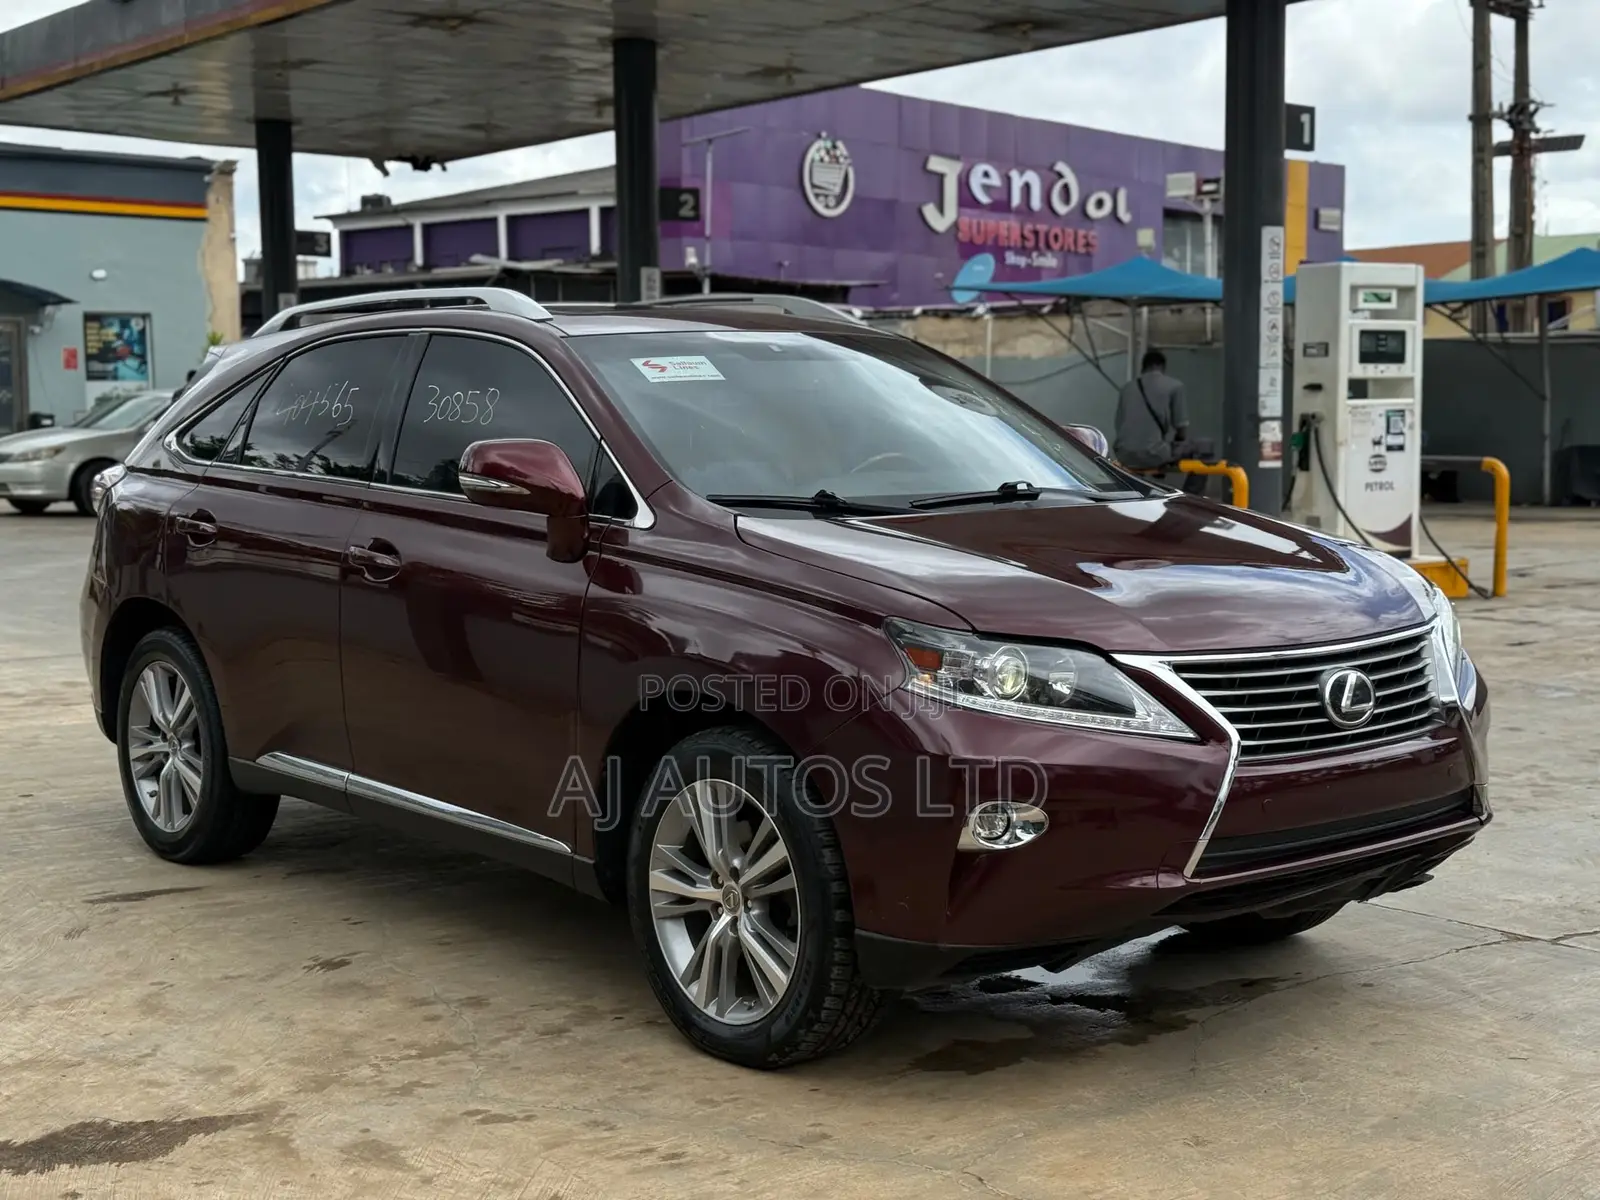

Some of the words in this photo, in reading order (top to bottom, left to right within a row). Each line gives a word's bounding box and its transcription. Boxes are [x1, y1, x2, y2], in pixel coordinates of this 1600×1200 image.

[1300, 112, 1311, 145] 1
[679, 193, 696, 218] 2
[314, 233, 328, 253] 3
[957, 216, 1099, 254] SUPERSTORES
[423, 384, 500, 426] 30858
[1365, 481, 1395, 492] PETROL
